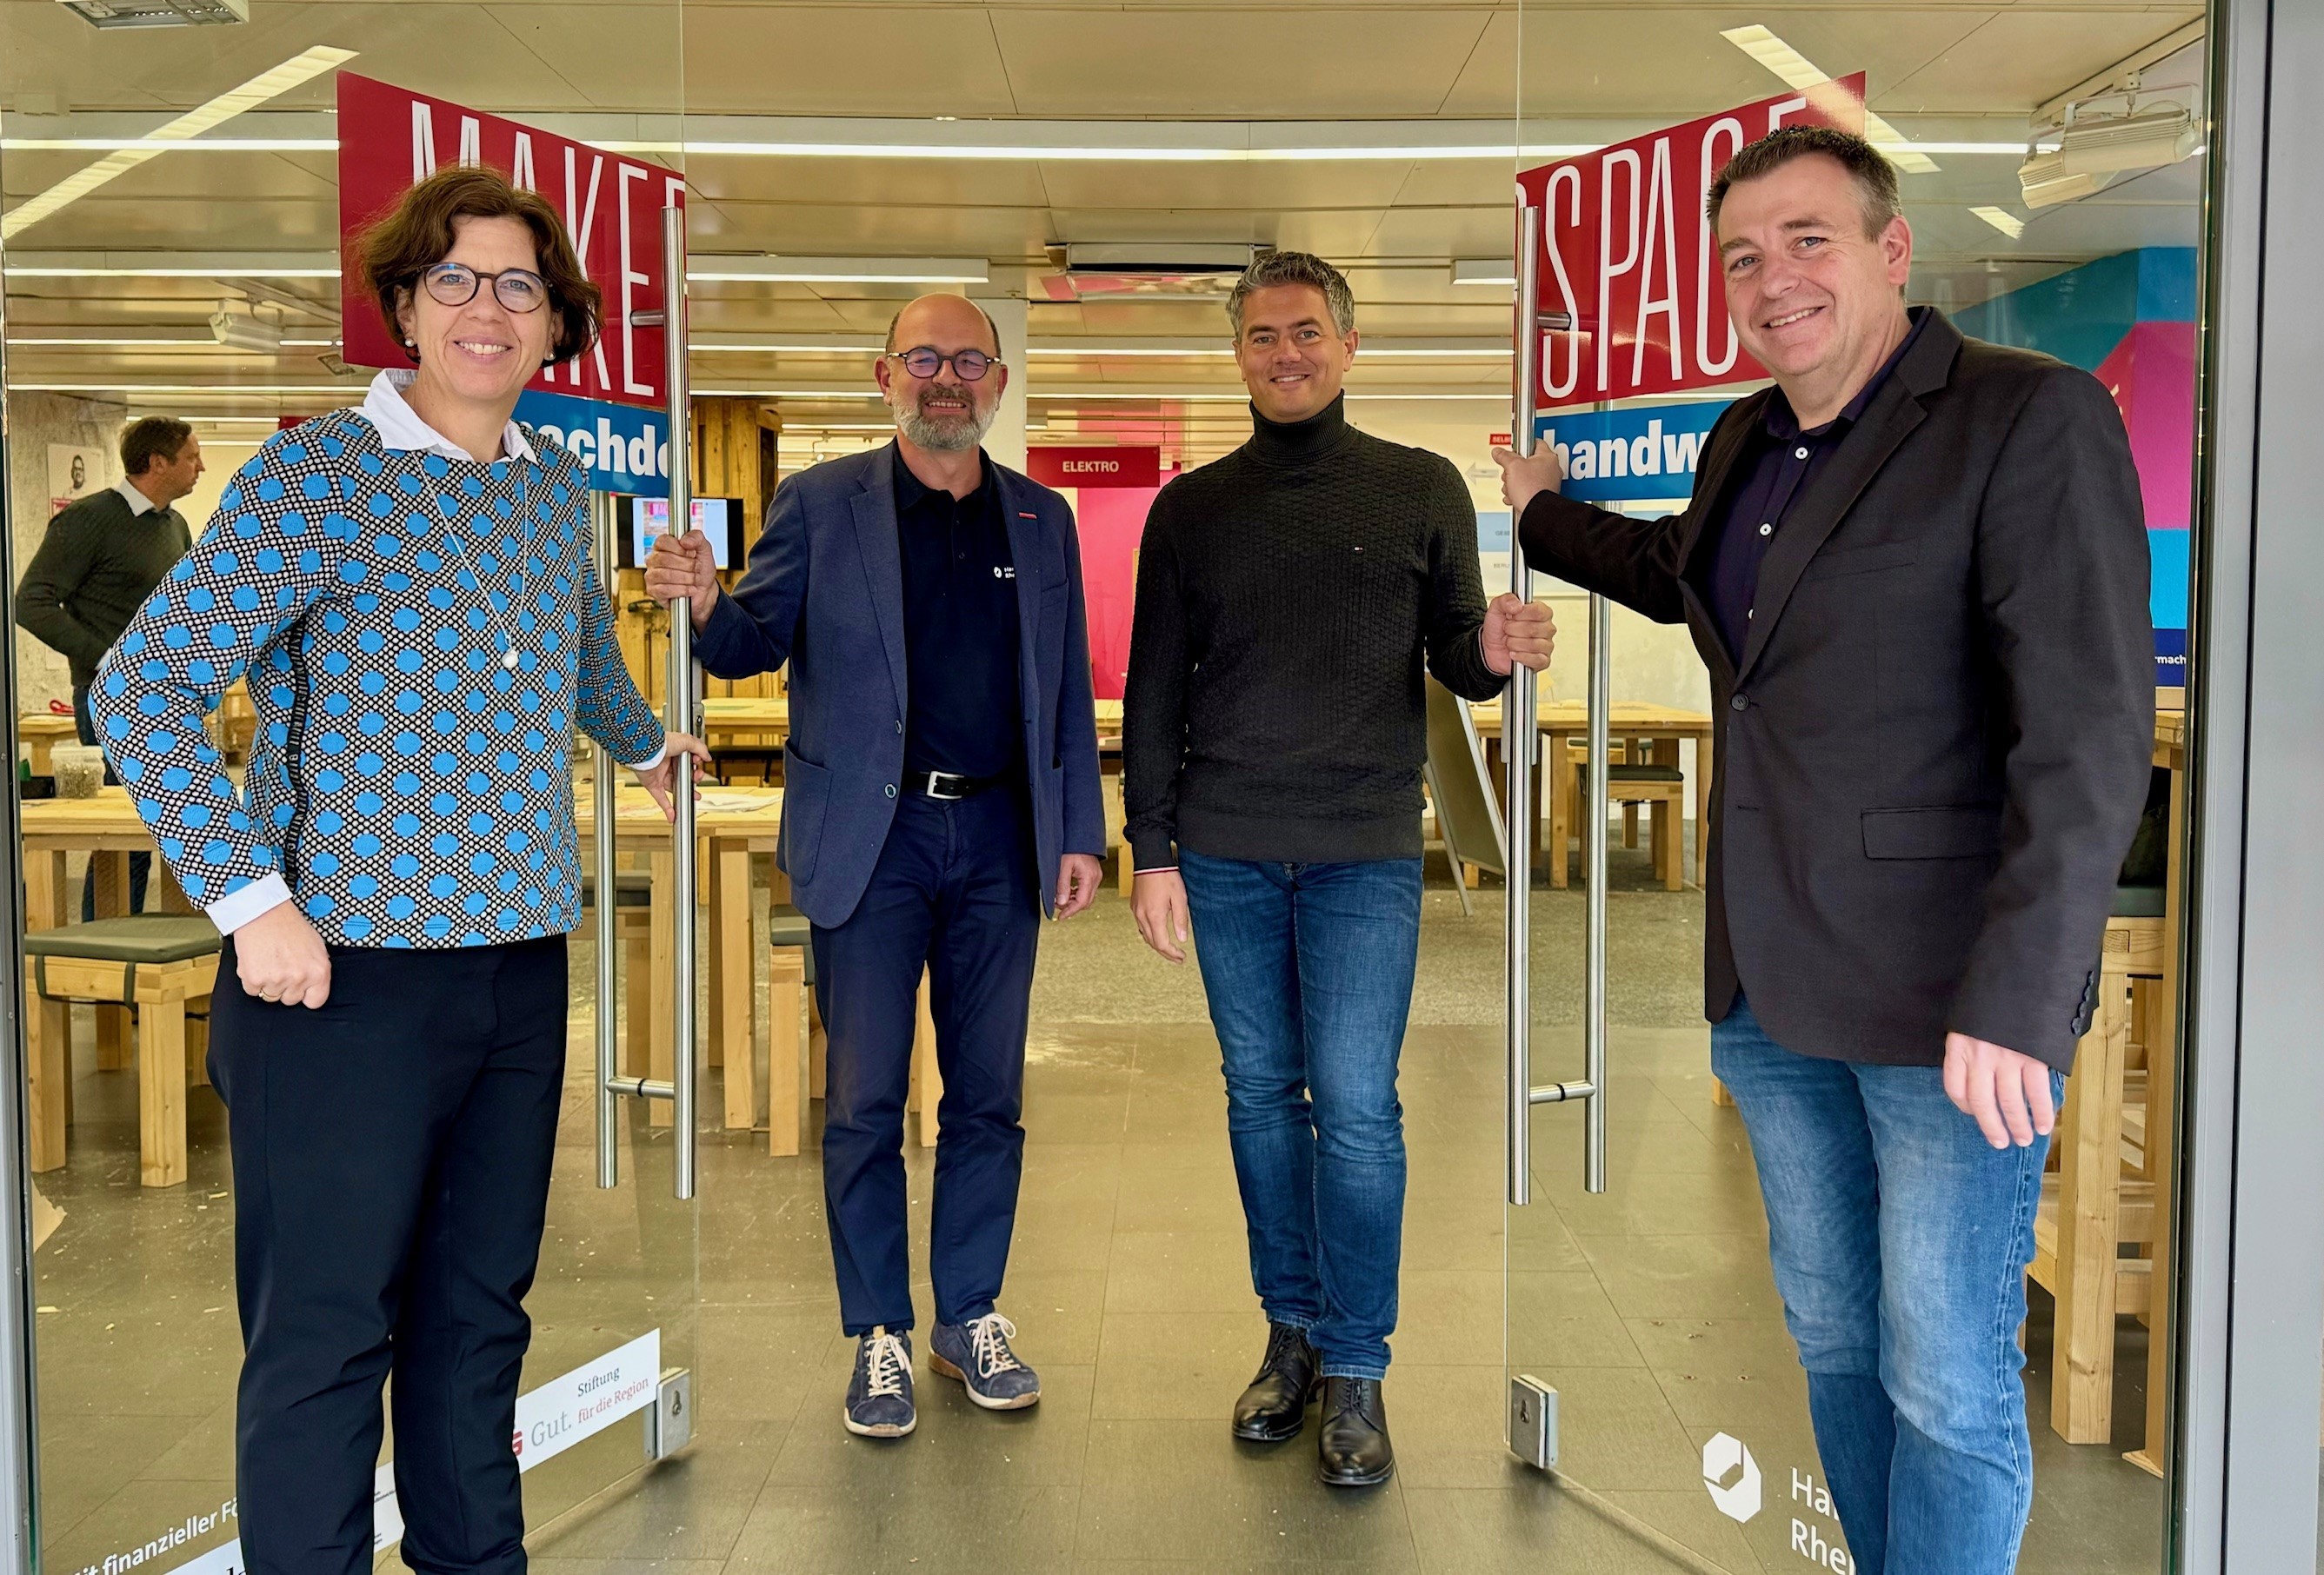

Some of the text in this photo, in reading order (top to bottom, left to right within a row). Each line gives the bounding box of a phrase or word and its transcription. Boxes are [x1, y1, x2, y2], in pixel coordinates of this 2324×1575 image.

[1516, 97, 1807, 398] SPAC
[1062, 461, 1120, 473] ELEKTRO
[577, 1367, 620, 1397] Stiftung
[578, 1378, 649, 1424] für die Region
[531, 1412, 572, 1446] Gut.
[102, 1511, 217, 1575] finanzieller
